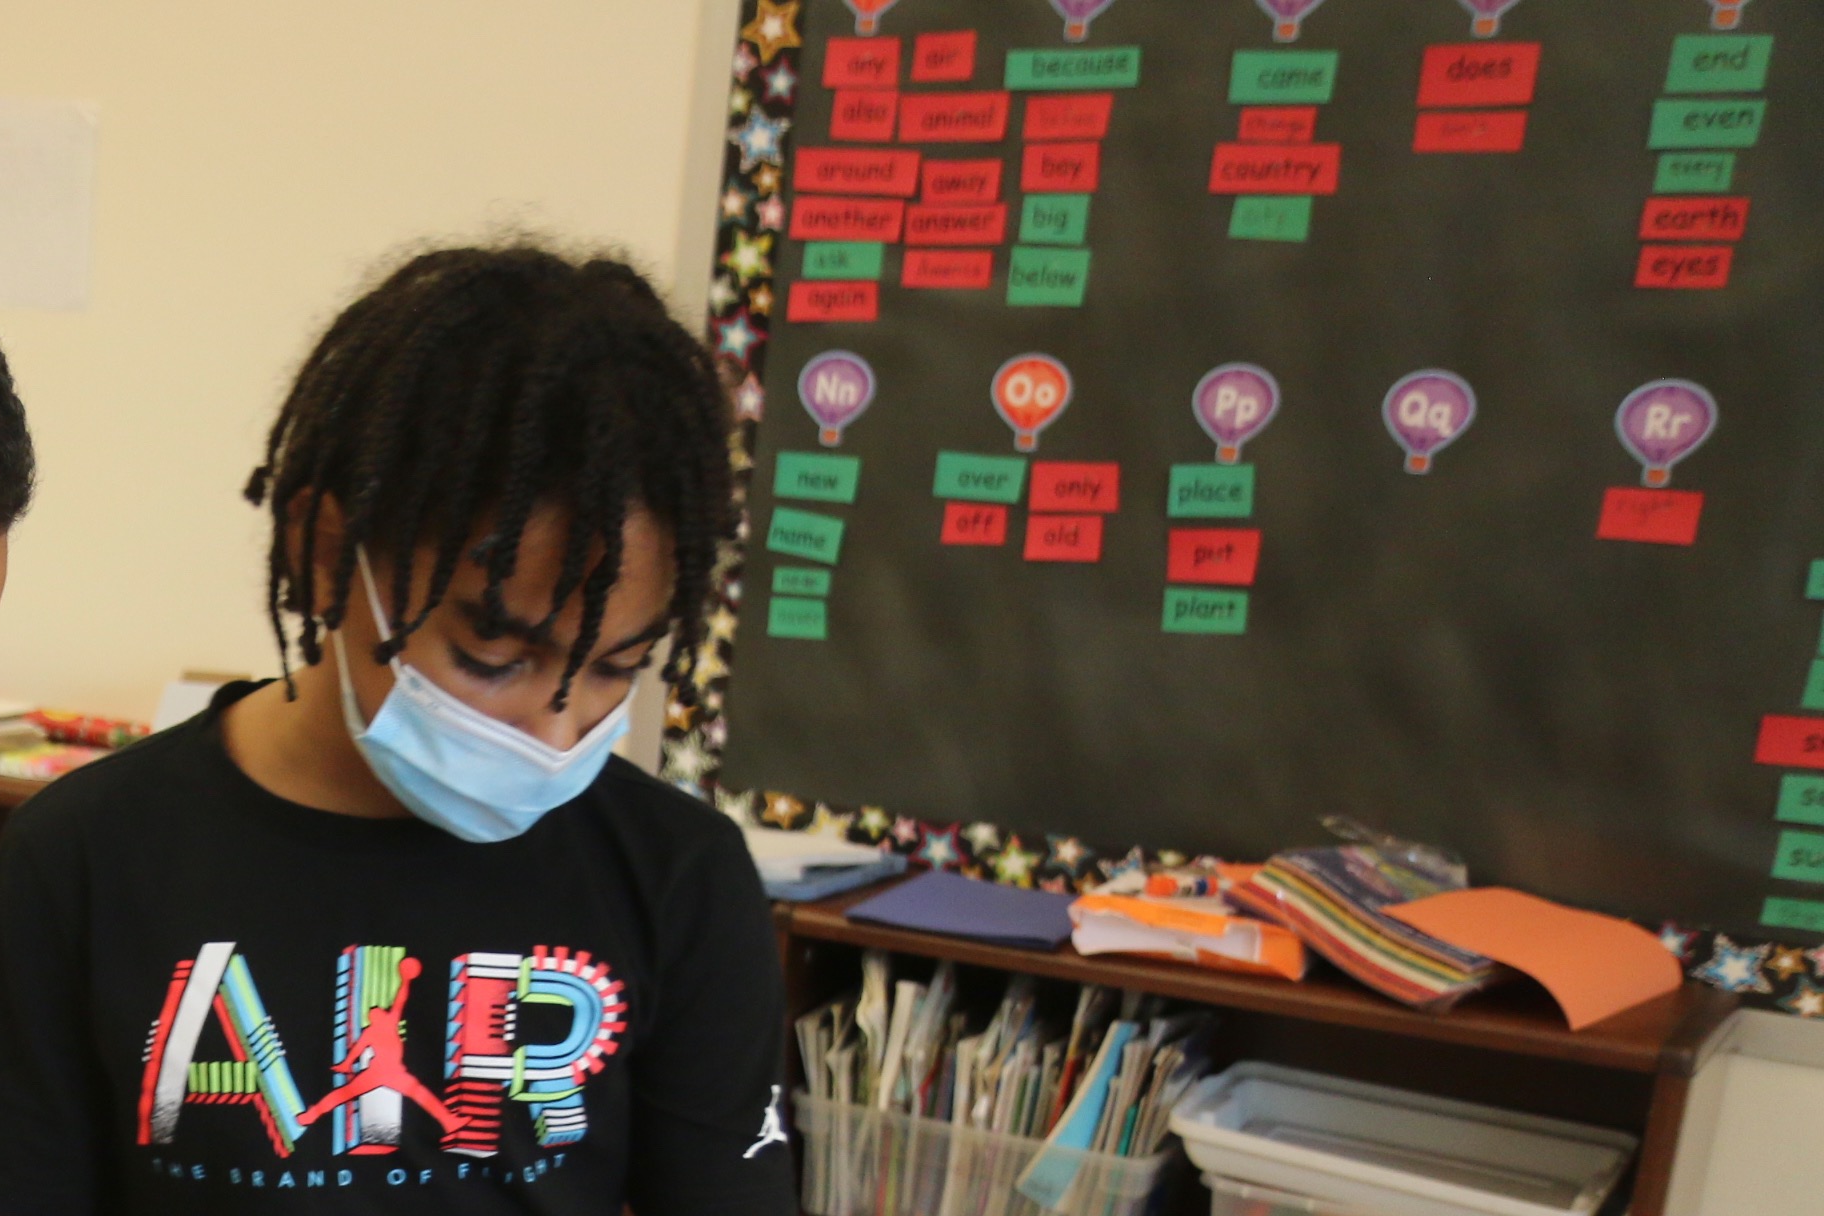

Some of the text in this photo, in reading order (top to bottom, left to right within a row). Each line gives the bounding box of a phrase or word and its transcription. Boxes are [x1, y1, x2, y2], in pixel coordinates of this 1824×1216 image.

[846, 53, 887, 77] any
[925, 48, 960, 69] air
[1031, 53, 1129, 79] because
[1446, 54, 1513, 83] does
[1691, 43, 1752, 72] end
[842, 101, 889, 123] also
[920, 104, 996, 131] animal
[1682, 107, 1755, 132] even
[815, 161, 896, 182] around
[1041, 153, 1083, 180] boy
[1221, 160, 1322, 184] country
[931, 175, 988, 194] away
[800, 209, 893, 230] another
[911, 213, 995, 233] answer
[1032, 203, 1070, 235] big
[1654, 204, 1739, 230] earth
[1011, 263, 1076, 289] below
[1650, 255, 1720, 285] eyes
[807, 290, 866, 312] again
[813, 369, 858, 407] Nn
[1004, 372, 1057, 409] Oo
[1214, 384, 1260, 429] Pp
[1397, 391, 1454, 438] Qq
[1641, 404, 1693, 441] Rr
[796, 470, 840, 489] new
[956, 469, 1009, 491] over
[1053, 477, 1102, 501] only
[1177, 480, 1244, 505] place
[955, 511, 995, 534] off
[772, 523, 827, 549] name
[1042, 525, 1080, 547] old
[1173, 597, 1236, 622] plant
[137, 941, 628, 1158] AIR
[229, 1167, 354, 1188] BRAND
[386, 1167, 433, 1186] OF
